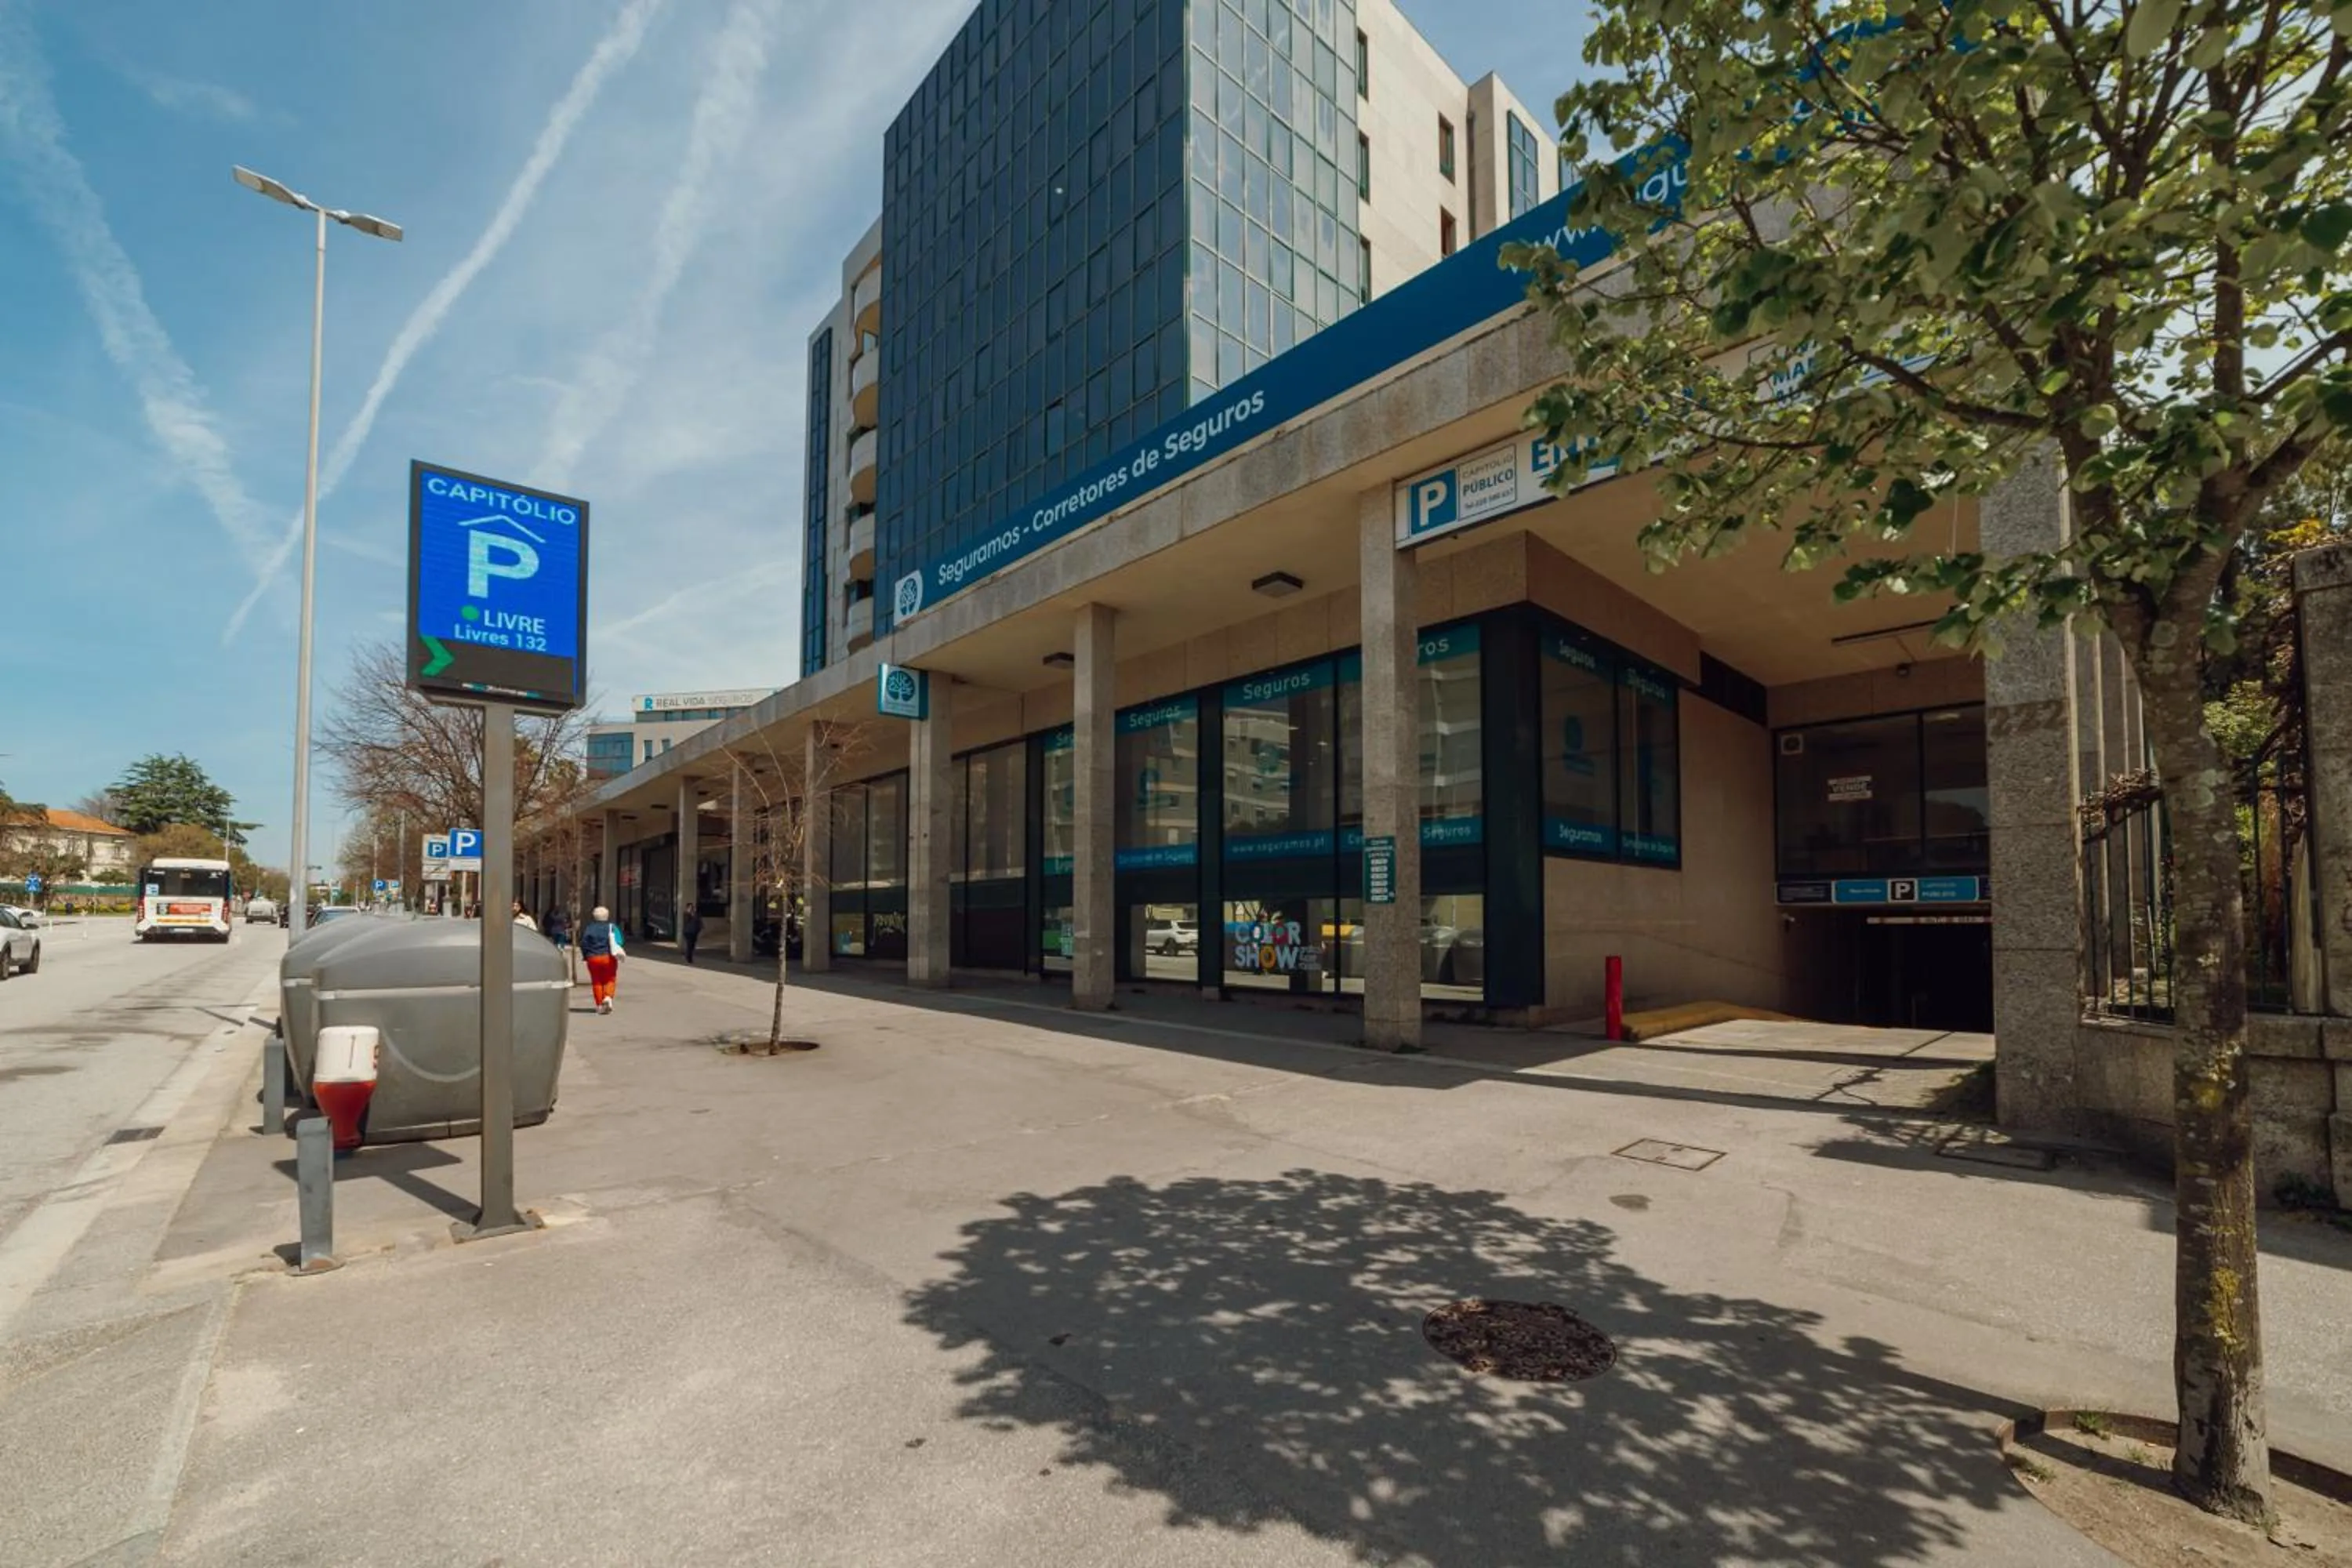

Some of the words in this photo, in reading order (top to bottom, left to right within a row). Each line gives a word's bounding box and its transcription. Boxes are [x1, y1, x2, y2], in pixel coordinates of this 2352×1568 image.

[938, 526, 1020, 585] Seguramos
[1033, 466, 1127, 532] Corretores
[1132, 449, 1159, 477] de
[1164, 390, 1265, 459] Seguros
[427, 477, 576, 524] CAPITÓLIO
[1419, 480, 1447, 526] P
[468, 529, 539, 598] P
[484, 609, 546, 635] LIVRE
[454, 624, 509, 645] Livres
[516, 636, 546, 652] 132
[1243, 671, 1311, 700] Seguros
[655, 696, 680, 707] REAL
[683, 696, 705, 706] VIDA
[1129, 705, 1181, 728] Seguros
[456, 832, 476, 855] P
[1423, 826, 1472, 840] Seguros
[432, 844, 444, 855] P
[1894, 882, 1911, 898] P
[1234, 945, 1299, 969] SHOW
